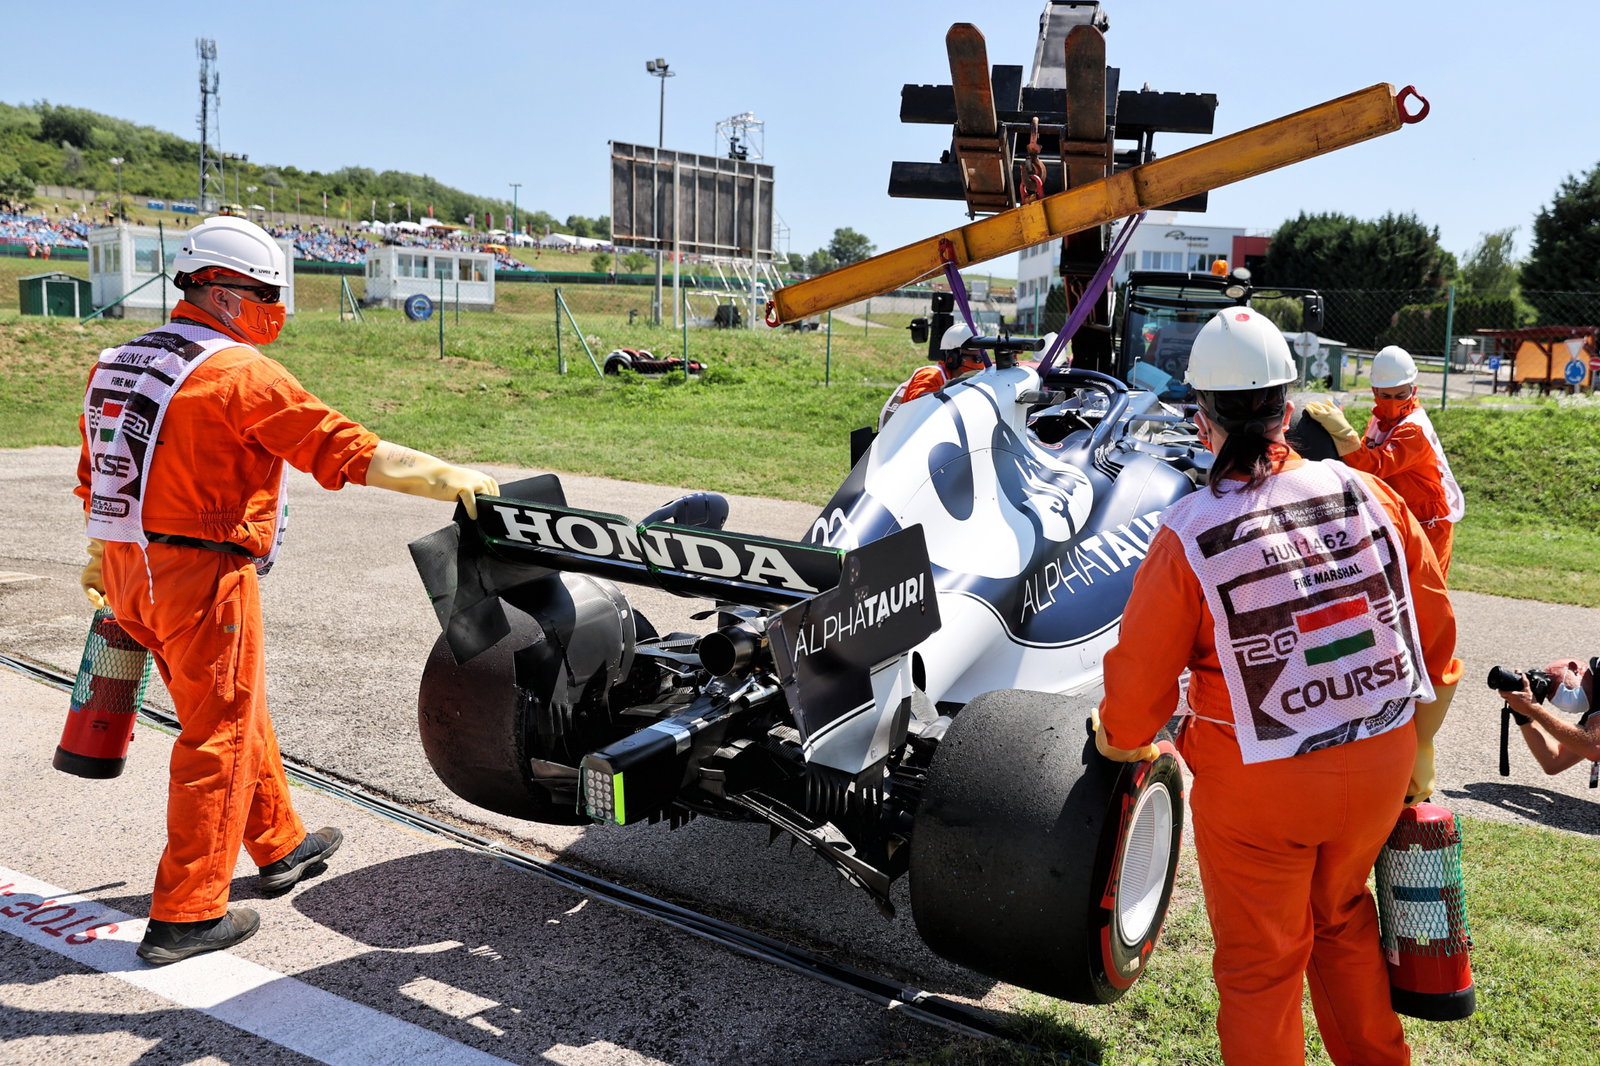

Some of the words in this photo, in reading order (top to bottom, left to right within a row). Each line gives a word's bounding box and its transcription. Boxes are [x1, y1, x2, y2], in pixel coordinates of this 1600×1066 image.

[111, 376, 123, 387] FIRE
[1059, 367, 1072, 375] 22
[493, 505, 819, 594] HONDA
[1293, 574, 1312, 590] FIRE
[1314, 563, 1363, 585] MARSHAL
[794, 572, 925, 663] ALPHATAURI
[1280, 652, 1410, 715] COURSE
[0, 899, 120, 946] STOP
